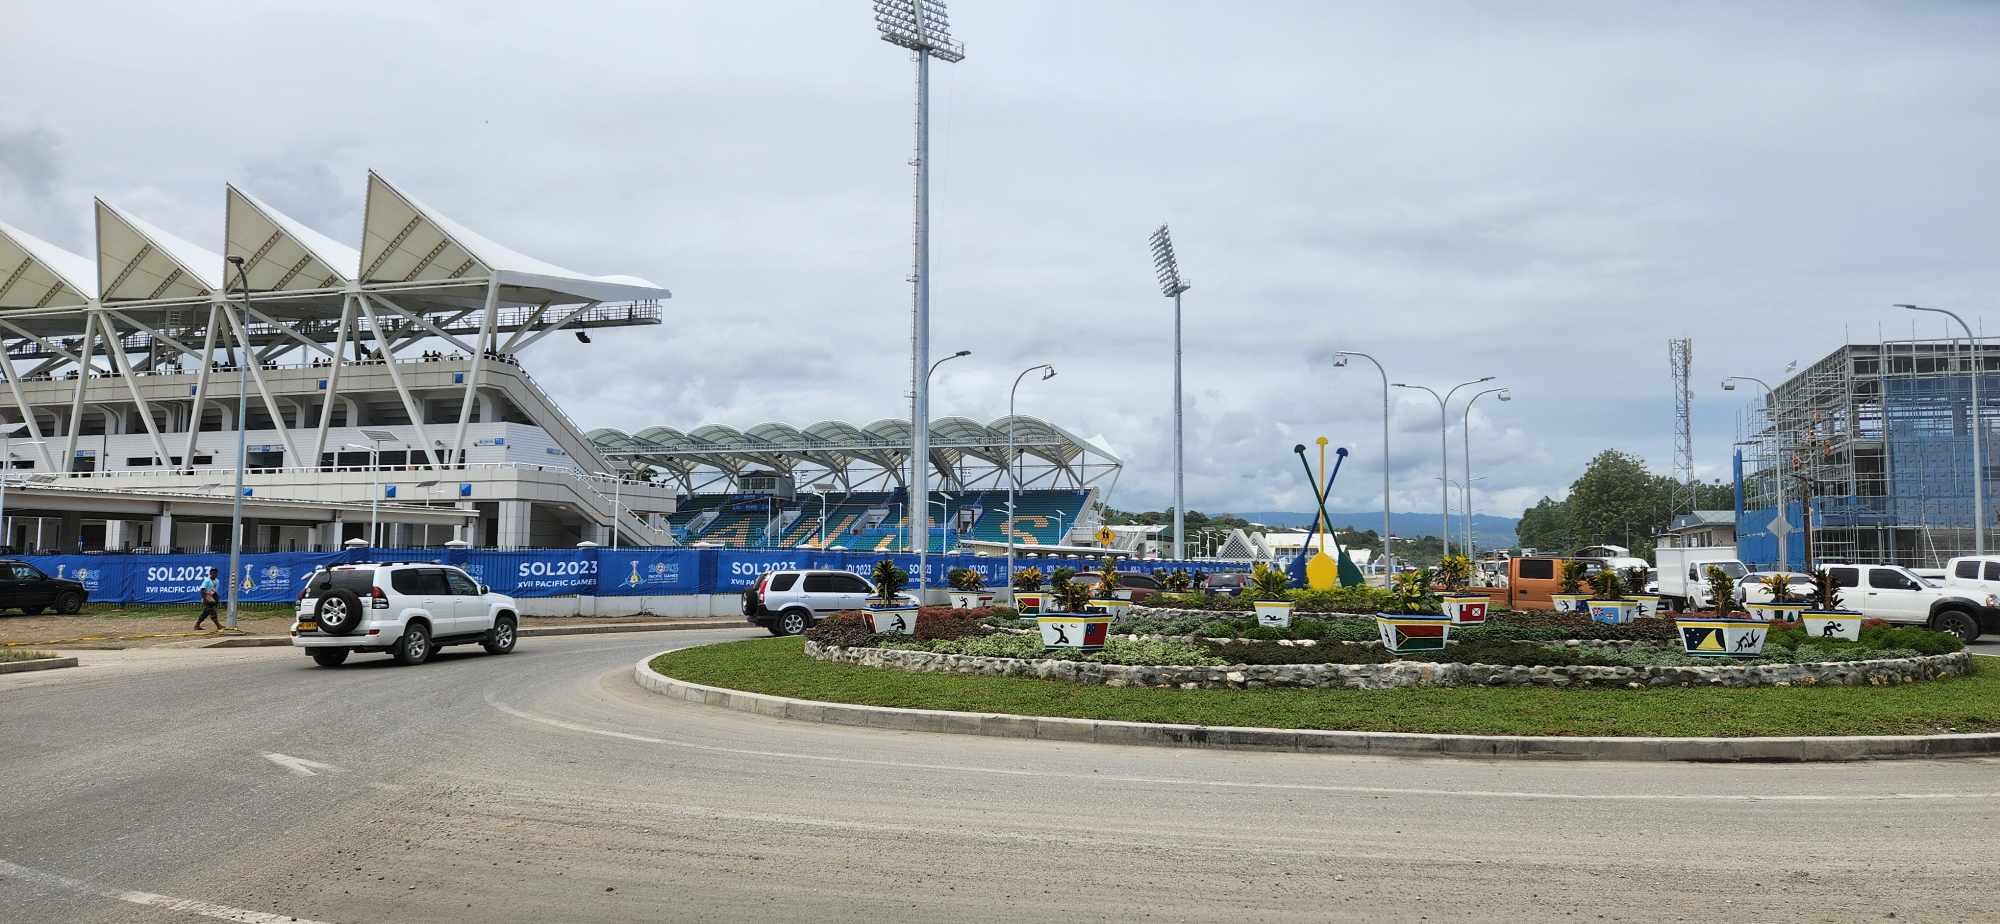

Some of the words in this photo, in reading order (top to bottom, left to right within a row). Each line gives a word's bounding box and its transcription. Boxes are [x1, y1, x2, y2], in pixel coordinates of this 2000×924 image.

[147, 566, 212, 581] SOL2023
[519, 561, 598, 576] SOL2023
[731, 561, 797, 576] SOL2023
[847, 563, 872, 576] OL2023
[908, 564, 932, 575] SO23
[186, 585, 202, 593] GAM
[517, 581, 533, 589] XVII
[535, 580, 569, 588] PACIFIC
[570, 578, 597, 586] GAMES
